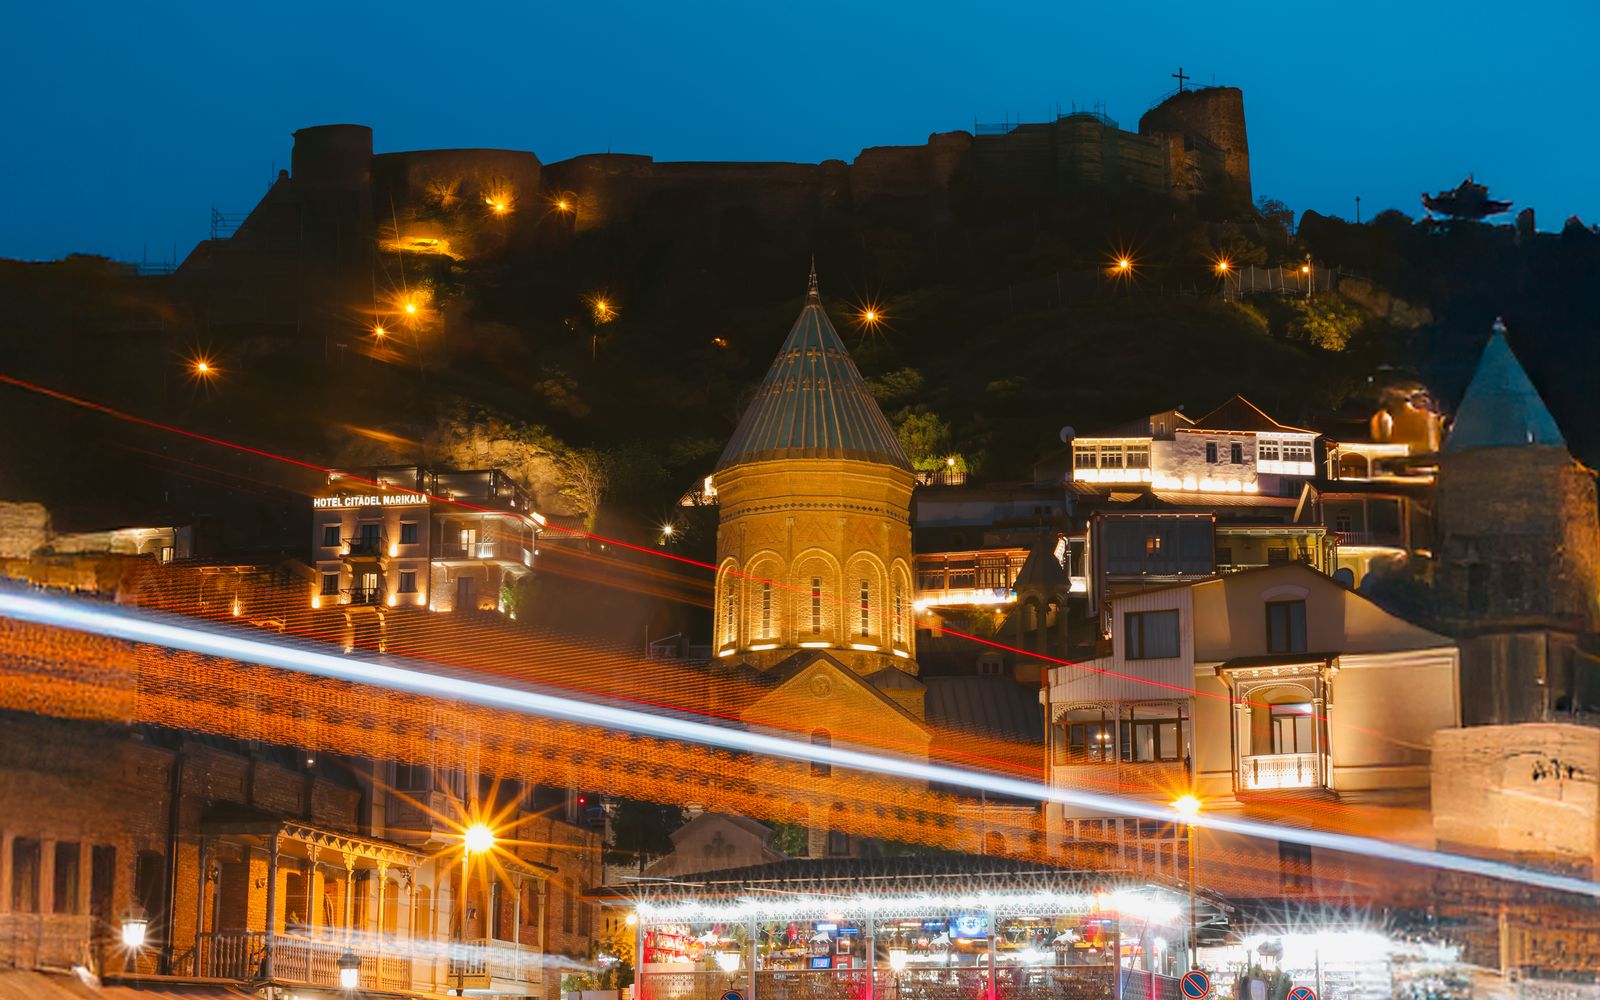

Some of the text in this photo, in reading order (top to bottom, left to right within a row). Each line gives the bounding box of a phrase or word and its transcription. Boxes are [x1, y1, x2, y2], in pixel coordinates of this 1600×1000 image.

[314, 493, 427, 507] HOTEL CITADEL NARIKALA
